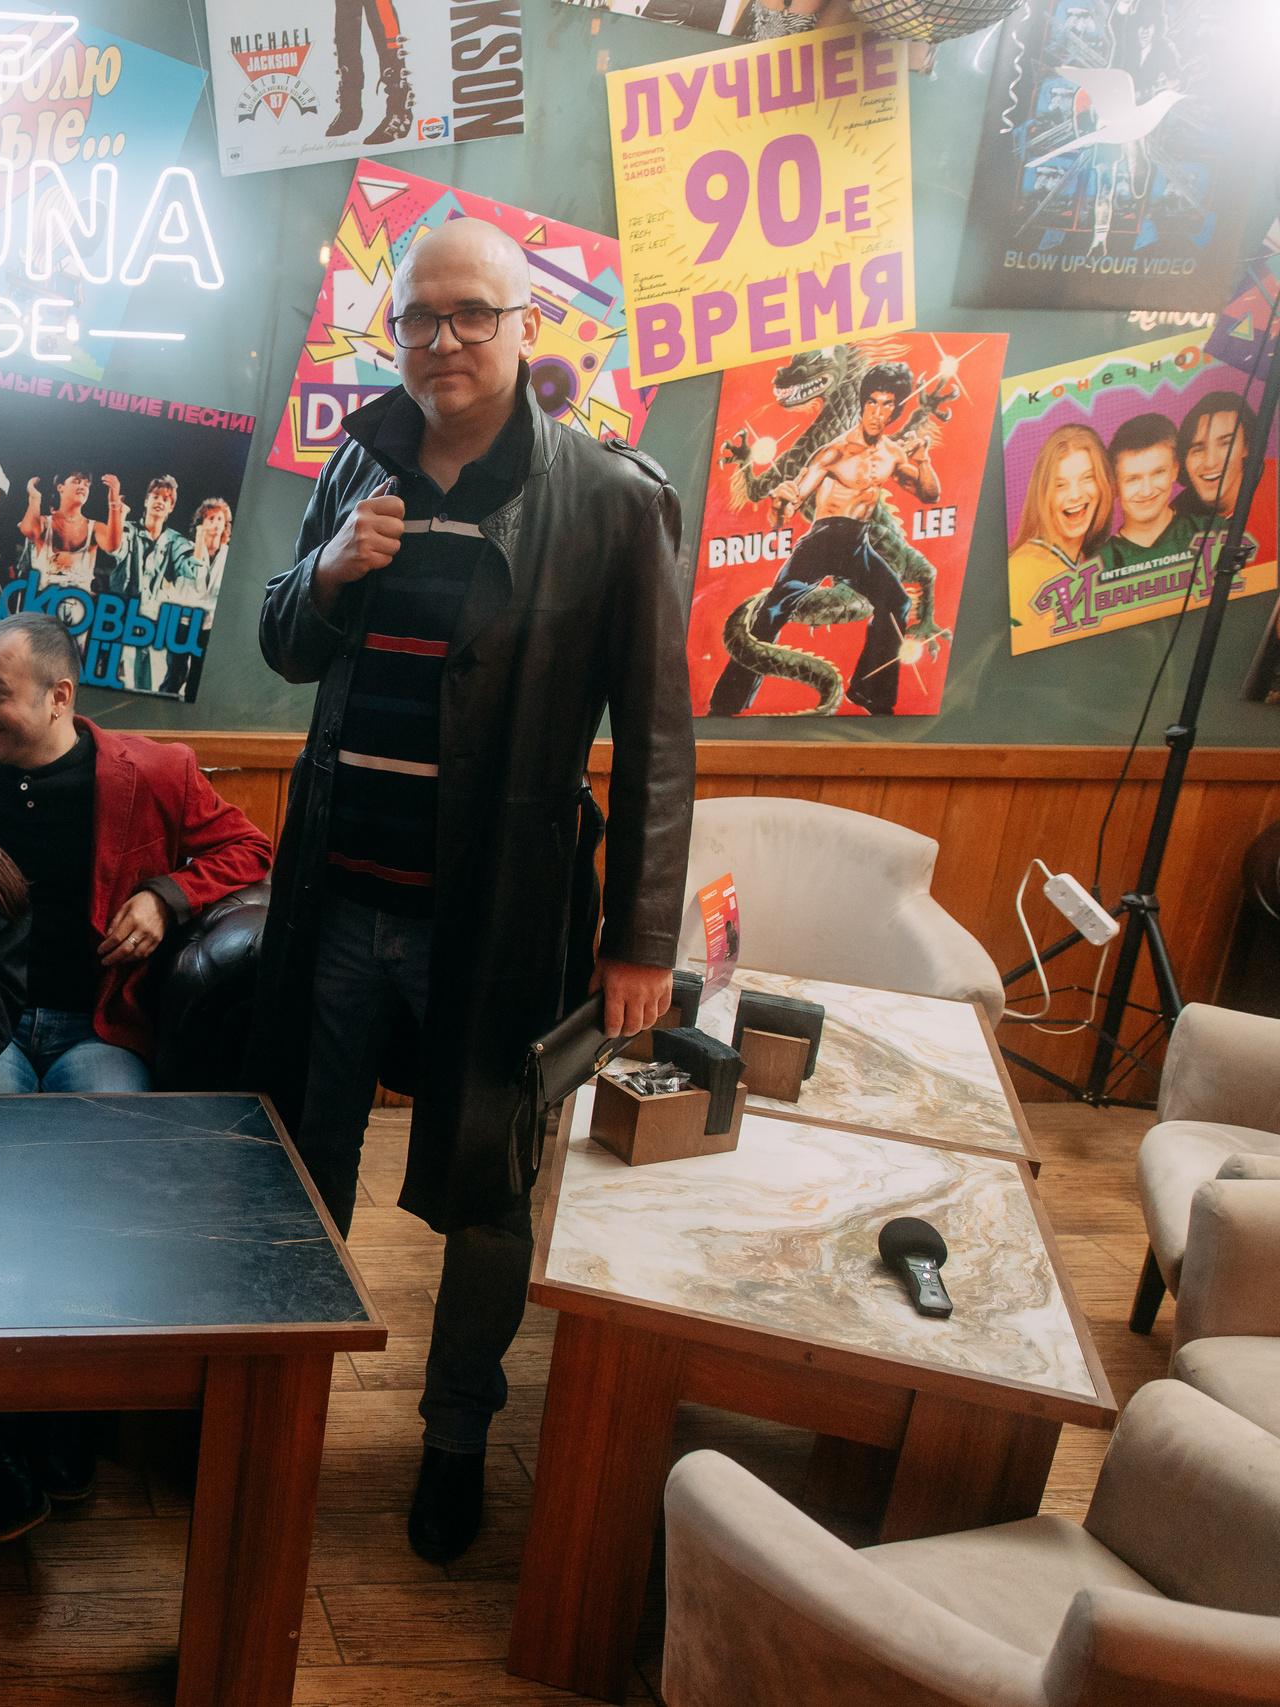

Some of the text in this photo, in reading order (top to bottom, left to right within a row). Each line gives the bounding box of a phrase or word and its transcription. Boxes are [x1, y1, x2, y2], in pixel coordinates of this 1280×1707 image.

[230, 28, 312, 54] MICHAEL
[247, 52, 298, 71] JACKSON
[450, 0, 524, 142] KSON
[238, 75, 316, 109] WORLD TOUR
[269, 93, 283, 109] 87
[620, 32, 899, 143] ЛУЧШЕЕ
[422, 124, 445, 134] PEPSI
[622, 146, 665, 161] Вспомнить
[629, 155, 665, 169] испытать
[625, 164, 666, 181] ЗАНОВО!
[685, 133, 872, 266] 90-Е
[628, 215, 643, 228] THE
[630, 242, 646, 253] THE
[1004, 251, 1197, 276] BLOW UP YOUR VIDEO
[634, 252, 903, 378] ВРЕМЯ
[57, 383, 164, 417] ЛУЧШИЕ
[167, 401, 256, 434] ПЕСНИ!
[306, 393, 386, 441] DI
[912, 506, 957, 542] LEE
[708, 528, 793, 569] BRUCE
[1100, 551, 1195, 581] INTERNATIONAL
